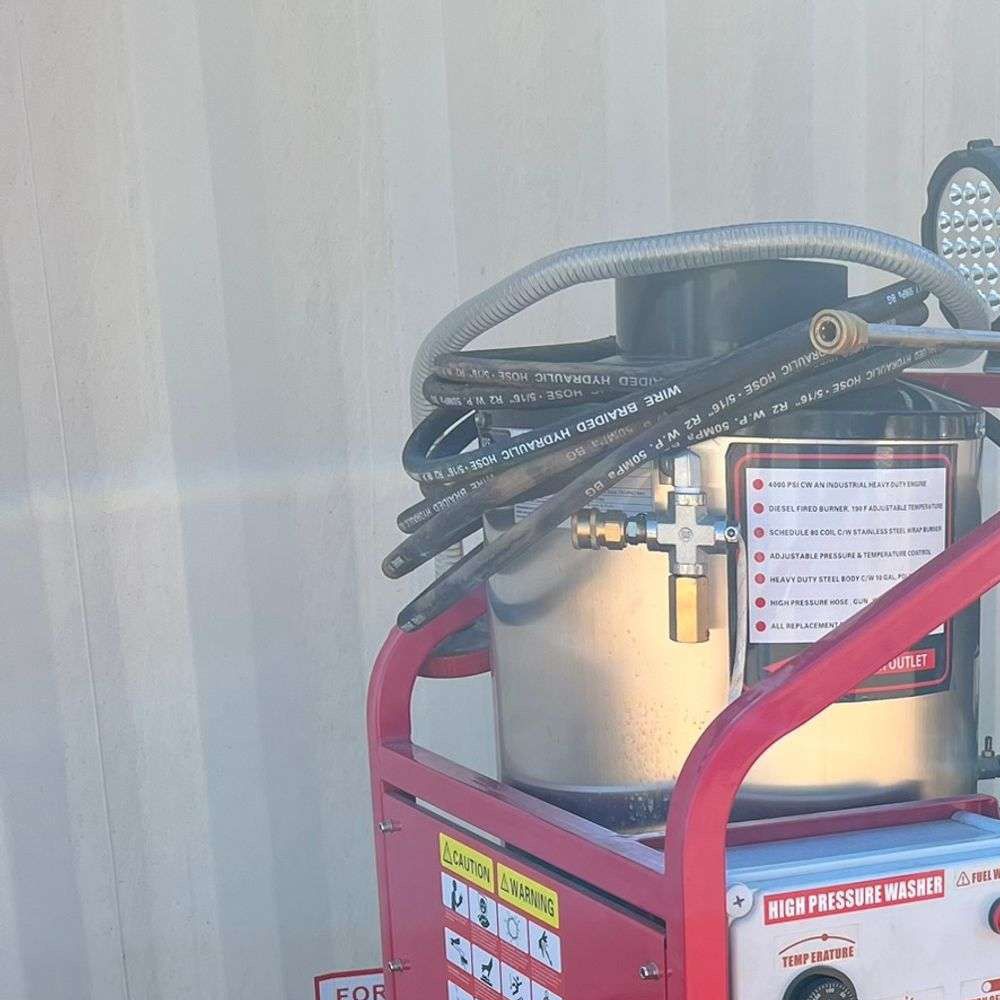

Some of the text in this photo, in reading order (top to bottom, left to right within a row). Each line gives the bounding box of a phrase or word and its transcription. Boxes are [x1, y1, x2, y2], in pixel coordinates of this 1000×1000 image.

[498, 370, 527, 381] HOSE
[535, 372, 611, 385] HYDRAULIC
[742, 372, 777, 395] HOSE
[831, 374, 861, 394] HOSE
[489, 394, 504, 405] R2
[643, 384, 682, 405] WIRE
[795, 388, 824, 407] 5/16"
[707, 392, 737, 417] 5/16"
[771, 400, 788, 416] R2
[576, 401, 638, 432] BRAIDED
[683, 413, 701, 431] R2
[734, 408, 766, 426] W.P.
[501, 426, 571, 461] HYDRAULIC
[649, 426, 680, 450] W.P.
[470, 452, 497, 470] HOSE
[607, 449, 647, 479] 50MPa
[584, 479, 603, 499] BG
[801, 481, 814, 489] CW
[814, 481, 825, 489] AN
[768, 505, 795, 513] DIESEL
[796, 505, 818, 513] FIRED
[869, 504, 907, 512] ADJUSTABLE
[769, 528, 809, 537] SCHEDULE
[854, 528, 888, 536] STAINLESS
[889, 527, 906, 535] STEEL
[770, 552, 818, 560] ADJUSTABLE
[819, 552, 856, 560] PRESSURE
[863, 550, 907, 558] TEMPERATURE
[770, 576, 797, 584] HEAVY
[797, 576, 817, 584] DUTY
[818, 575, 840, 583] STEEL
[841, 575, 860, 583] BODY
[770, 598, 790, 606] HIGH
[791, 598, 828, 606] PRESSURE
[771, 622, 785, 630] ALL
[888, 653, 928, 670] OUTLET
[452, 850, 491, 884] CAUTION
[972, 870, 992, 884] FUEL
[510, 877, 556, 918] WARNING
[768, 875, 944, 920] HIGH PRESSURE WASHER
[782, 946, 855, 968] TEMPERATURE
